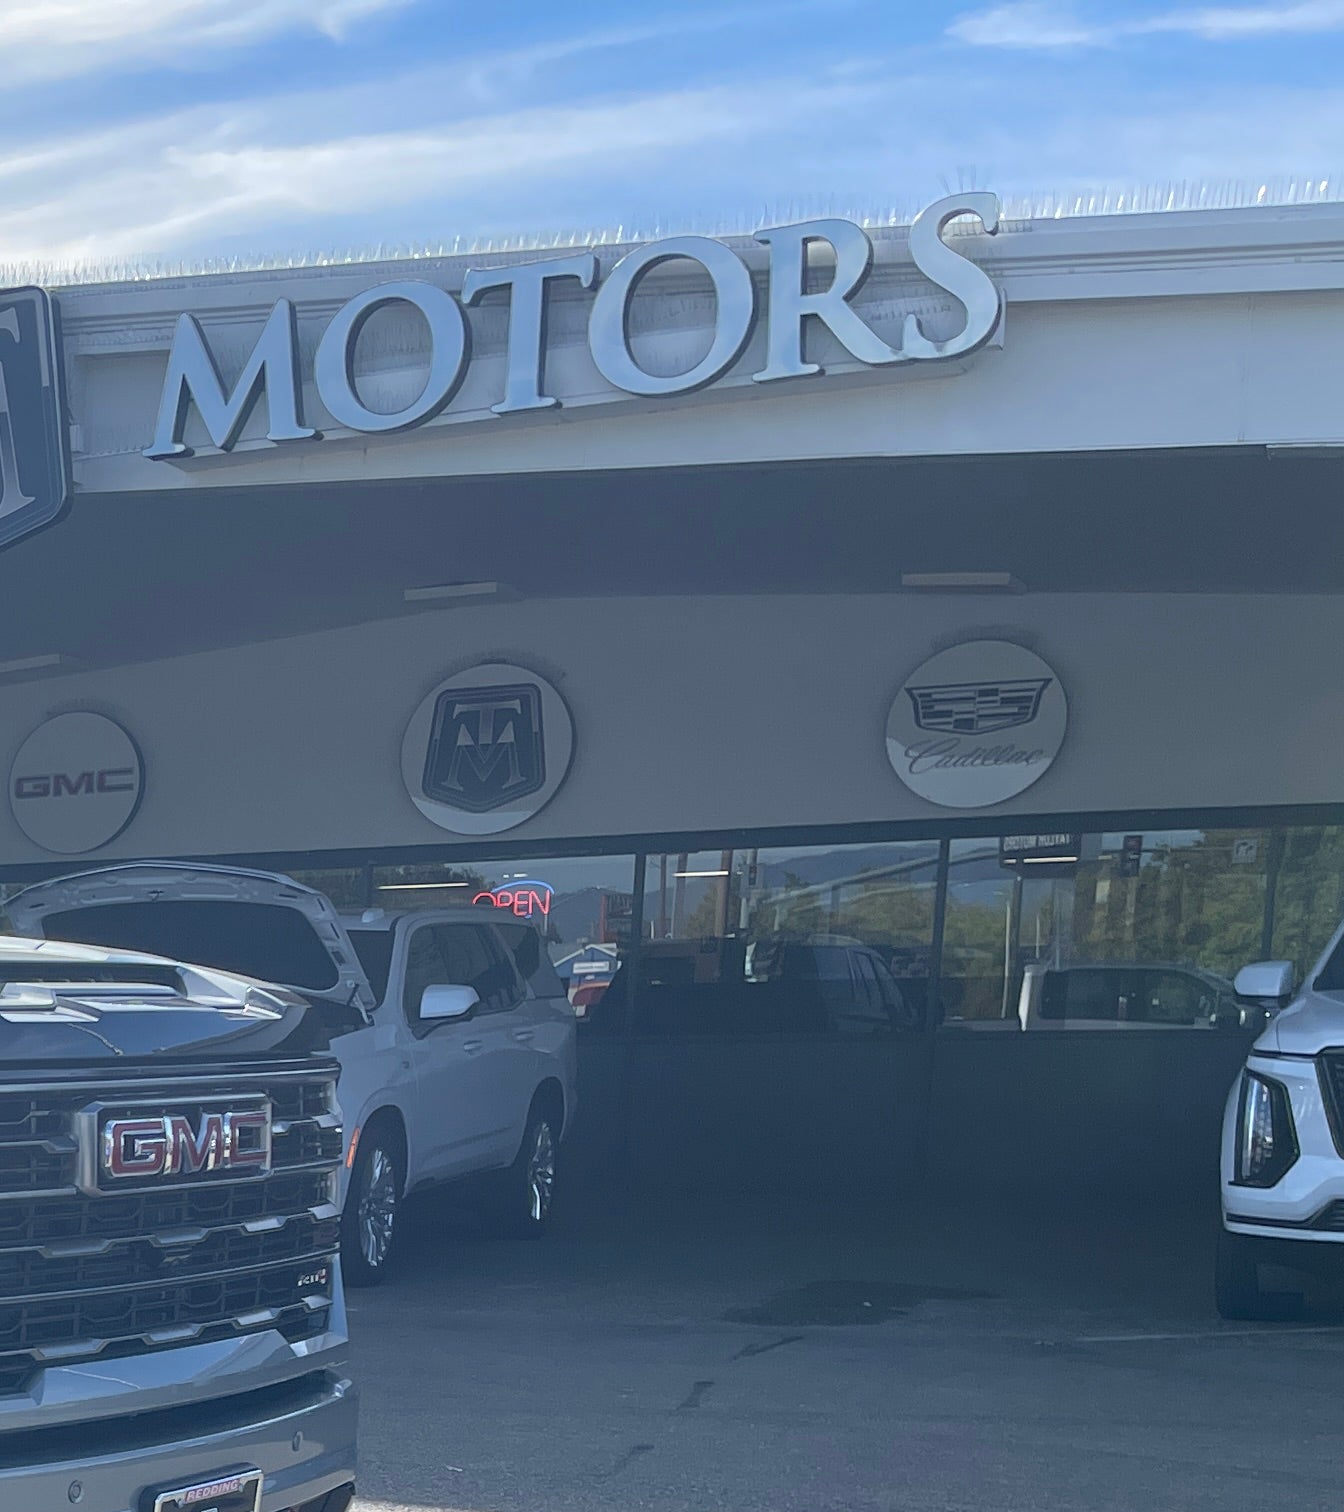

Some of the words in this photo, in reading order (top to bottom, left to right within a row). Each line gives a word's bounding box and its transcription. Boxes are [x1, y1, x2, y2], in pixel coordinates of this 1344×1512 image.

[143, 192, 1002, 461] MOTORS
[904, 737, 1044, 775] Cadillac
[15, 767, 134, 799] GMC
[472, 889, 552, 917] OPEN
[105, 1111, 269, 1178] GMC
[186, 1480, 240, 1501] REDDING
